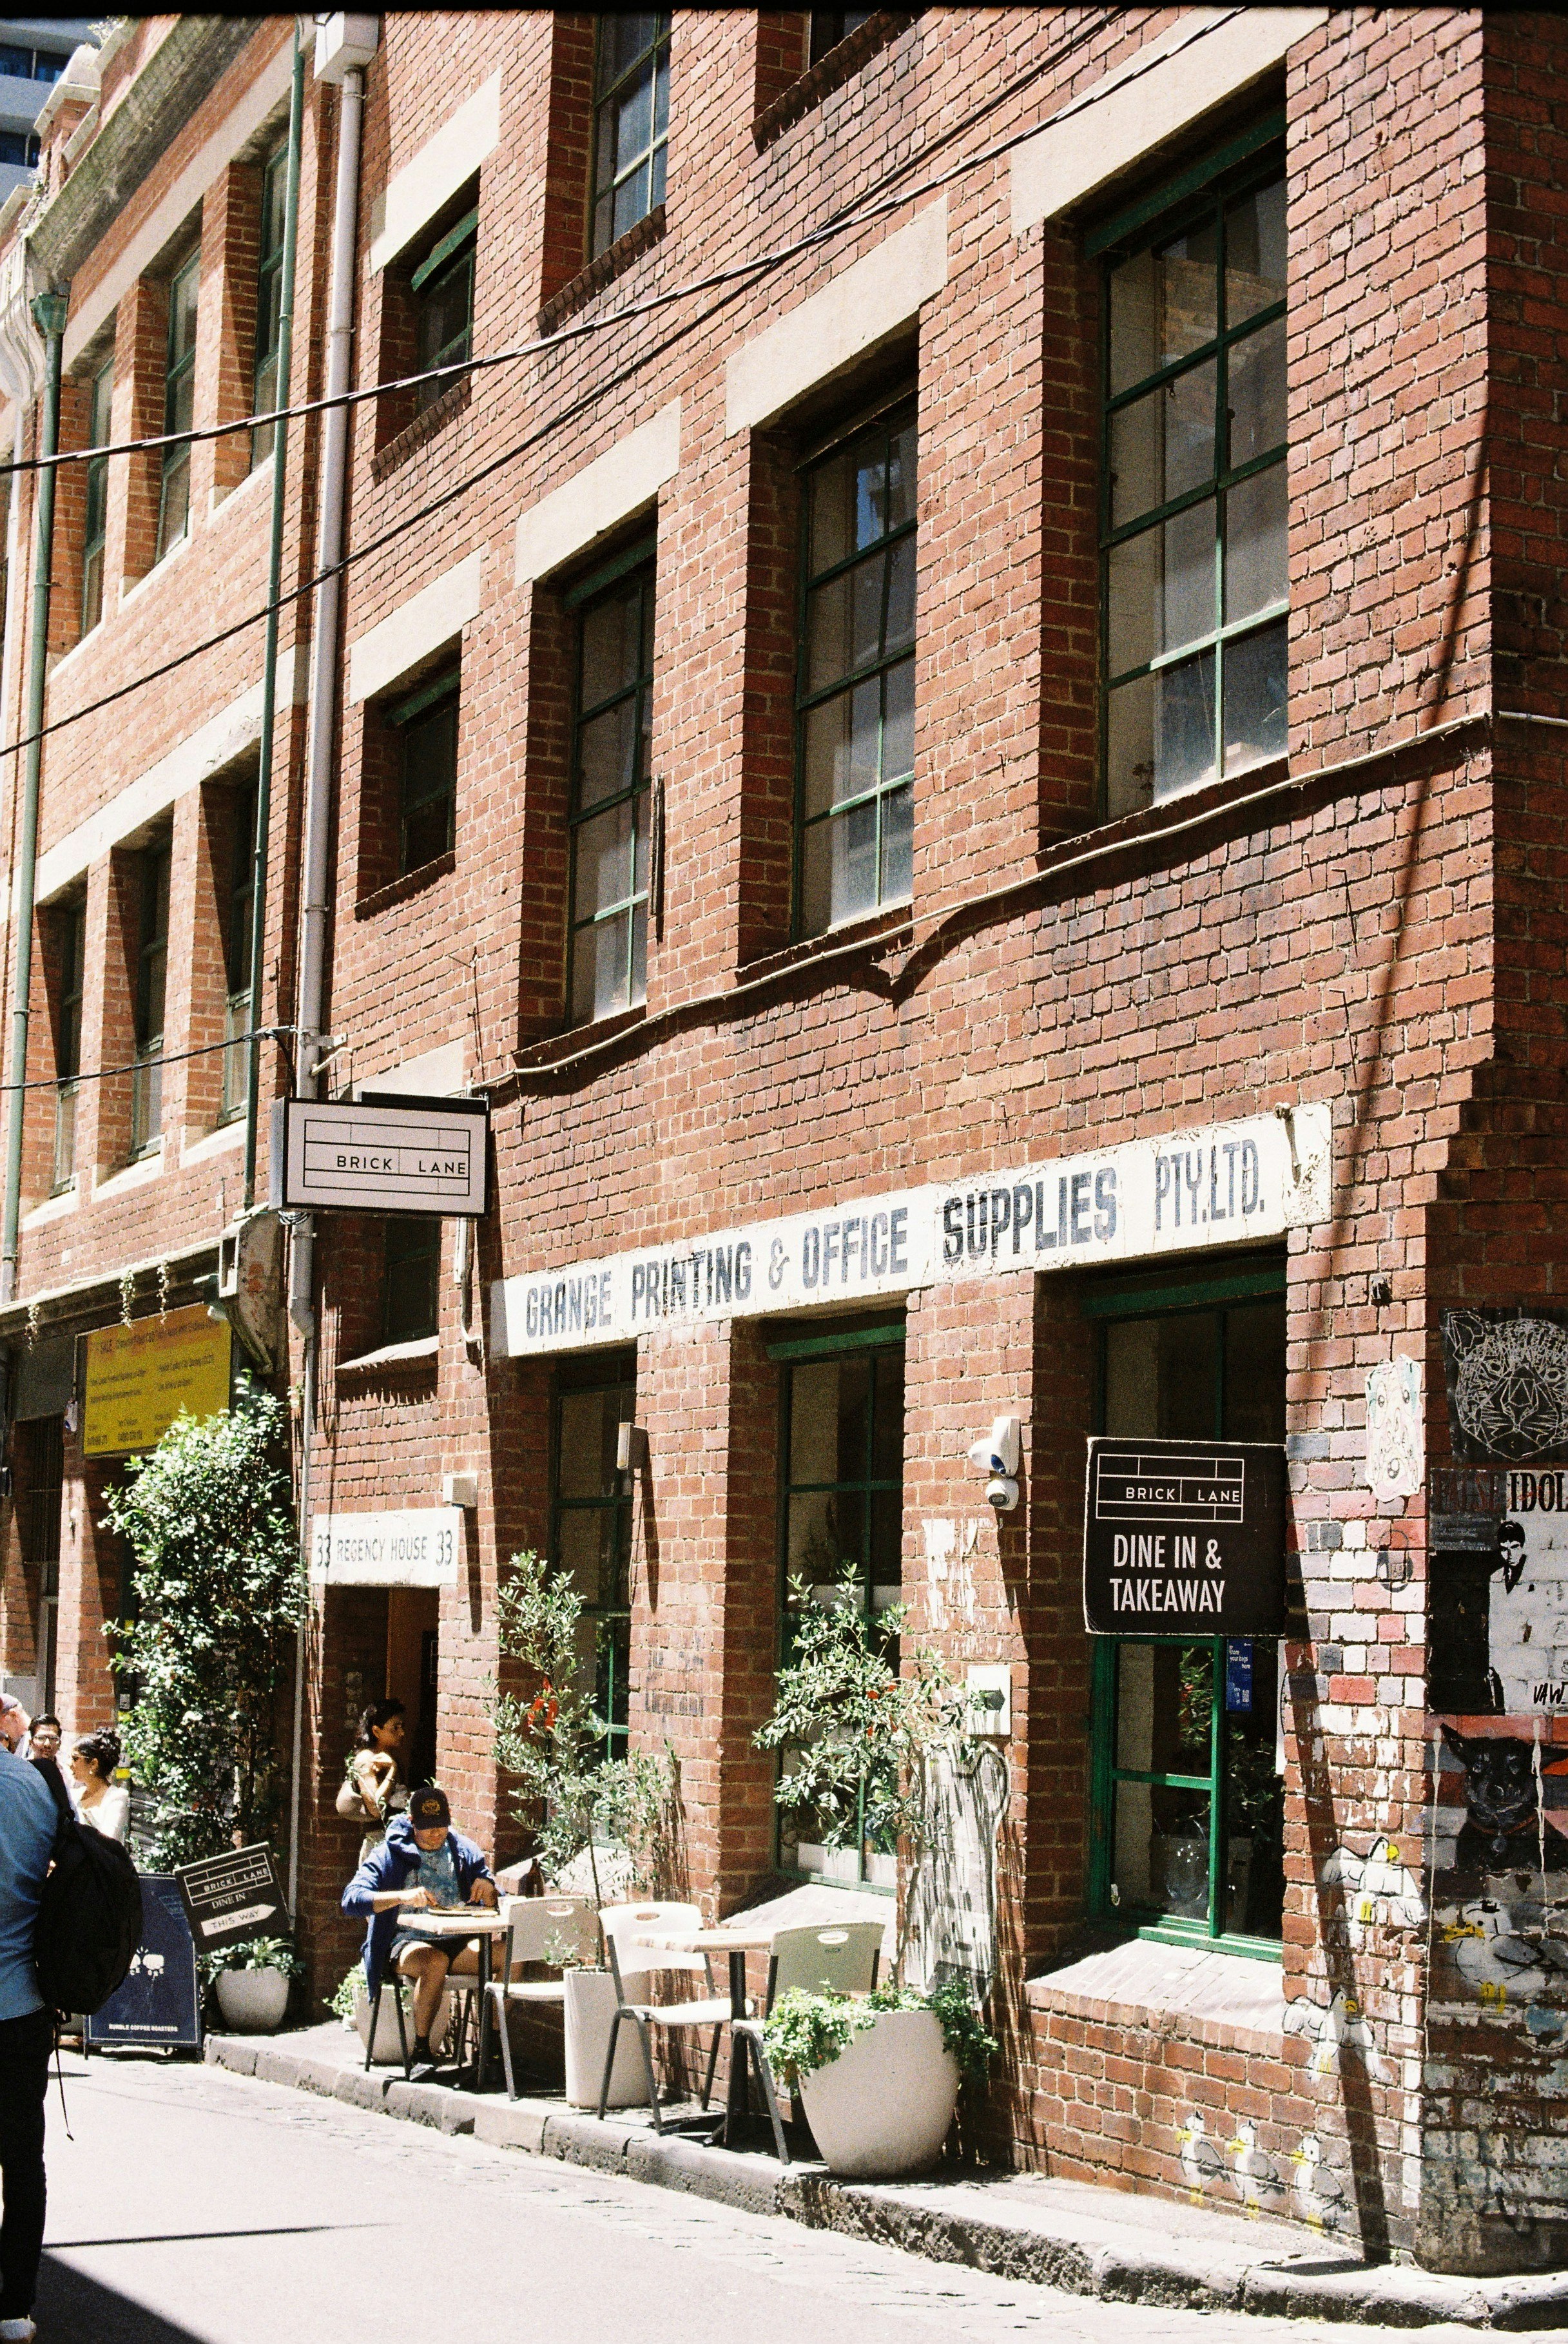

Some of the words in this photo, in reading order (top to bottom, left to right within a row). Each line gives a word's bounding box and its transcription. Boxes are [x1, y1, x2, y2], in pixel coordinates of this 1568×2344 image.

[337, 1155, 392, 1170] BRICK
[418, 1160, 467, 1175] LANE
[525, 1270, 612, 1339] GRANGE
[632, 1241, 752, 1321] PRINTING
[768, 1237, 791, 1290] &
[802, 1207, 909, 1290] OFFICE
[942, 1167, 1118, 1264] SUPPLIES
[1125, 1487, 1176, 1500] BRICK
[1197, 1489, 1240, 1502] LANE
[316, 1534, 331, 1568] 33
[337, 1538, 385, 1562] REGENCY
[391, 1536, 428, 1561] HOUSE
[435, 1529, 452, 1567] 33
[1114, 1535, 1166, 1568] DINE
[1174, 1536, 1196, 1568] IN
[1205, 1539, 1223, 1569] &
[1110, 1578, 1225, 1613] TAKEAWAY
[204, 1878, 233, 1892] BRICK
[244, 1868, 269, 1880] LANE
[211, 1895, 235, 1909] DINE
[235, 1892, 246, 1902] IN
[211, 1917, 235, 1929] THIS
[238, 1910, 259, 1920] WAY
